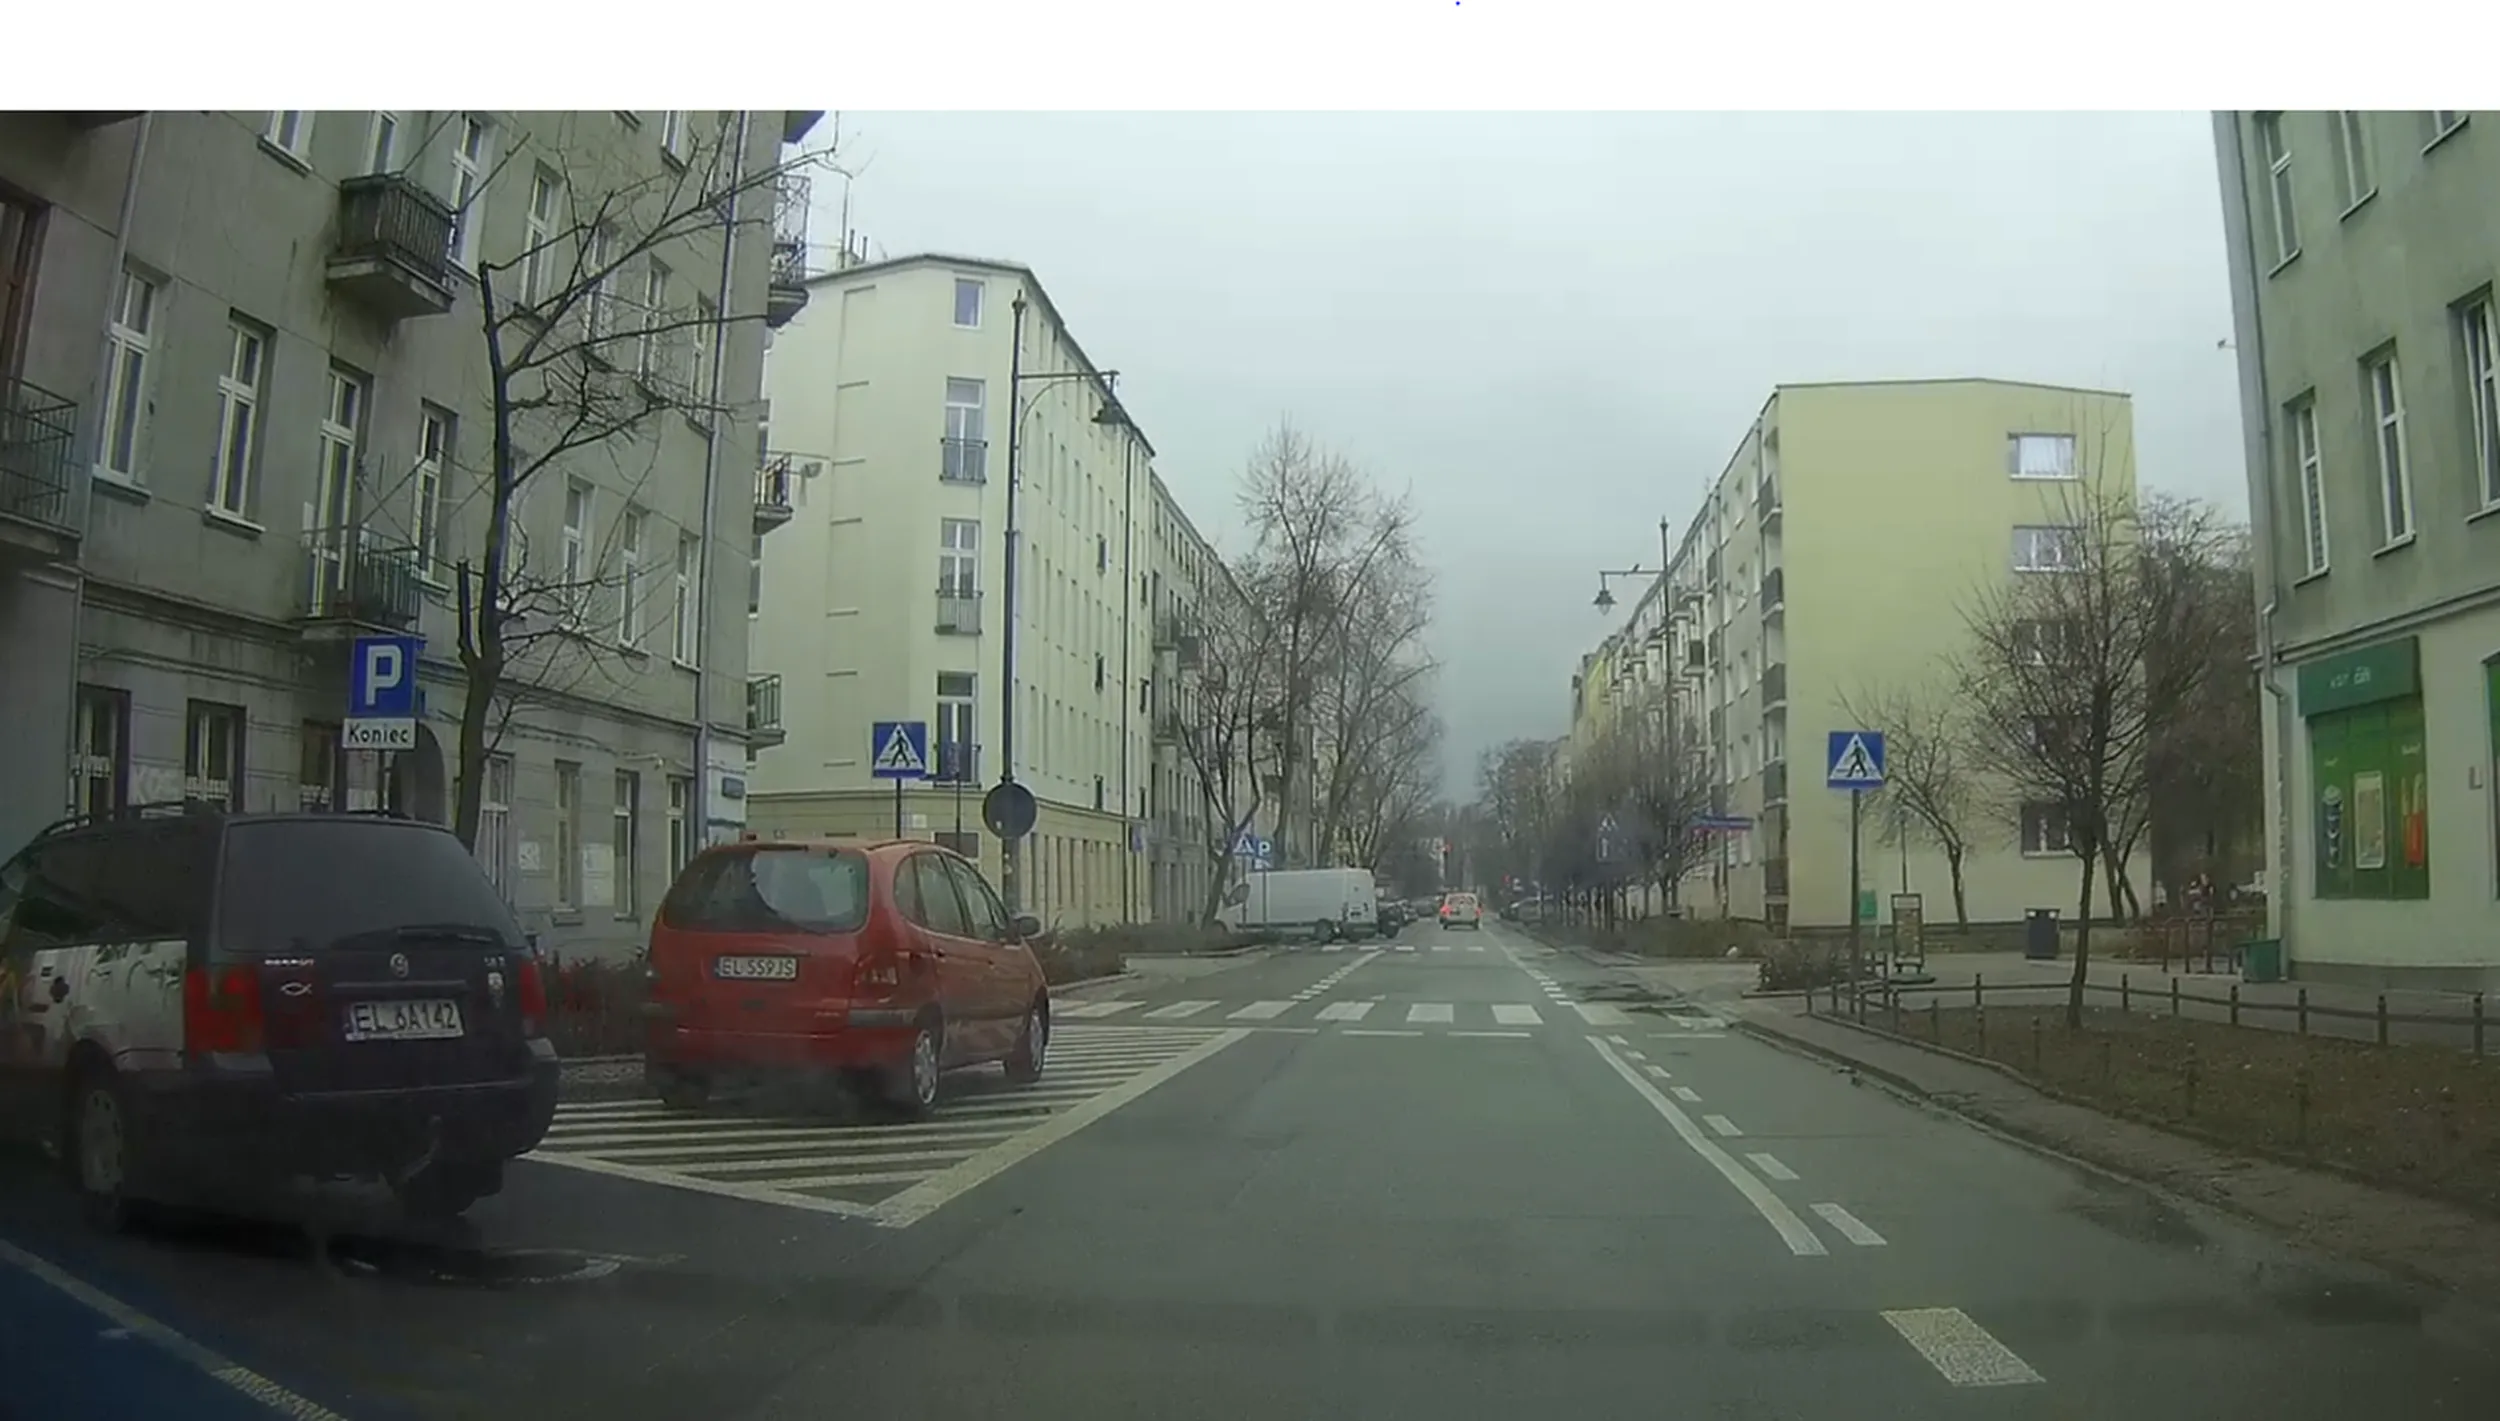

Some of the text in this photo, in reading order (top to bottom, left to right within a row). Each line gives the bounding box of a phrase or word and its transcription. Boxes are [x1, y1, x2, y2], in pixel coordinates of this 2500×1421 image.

[366, 645, 402, 705] P
[348, 723, 409, 742] Koniec
[1258, 841, 1271, 857] P
